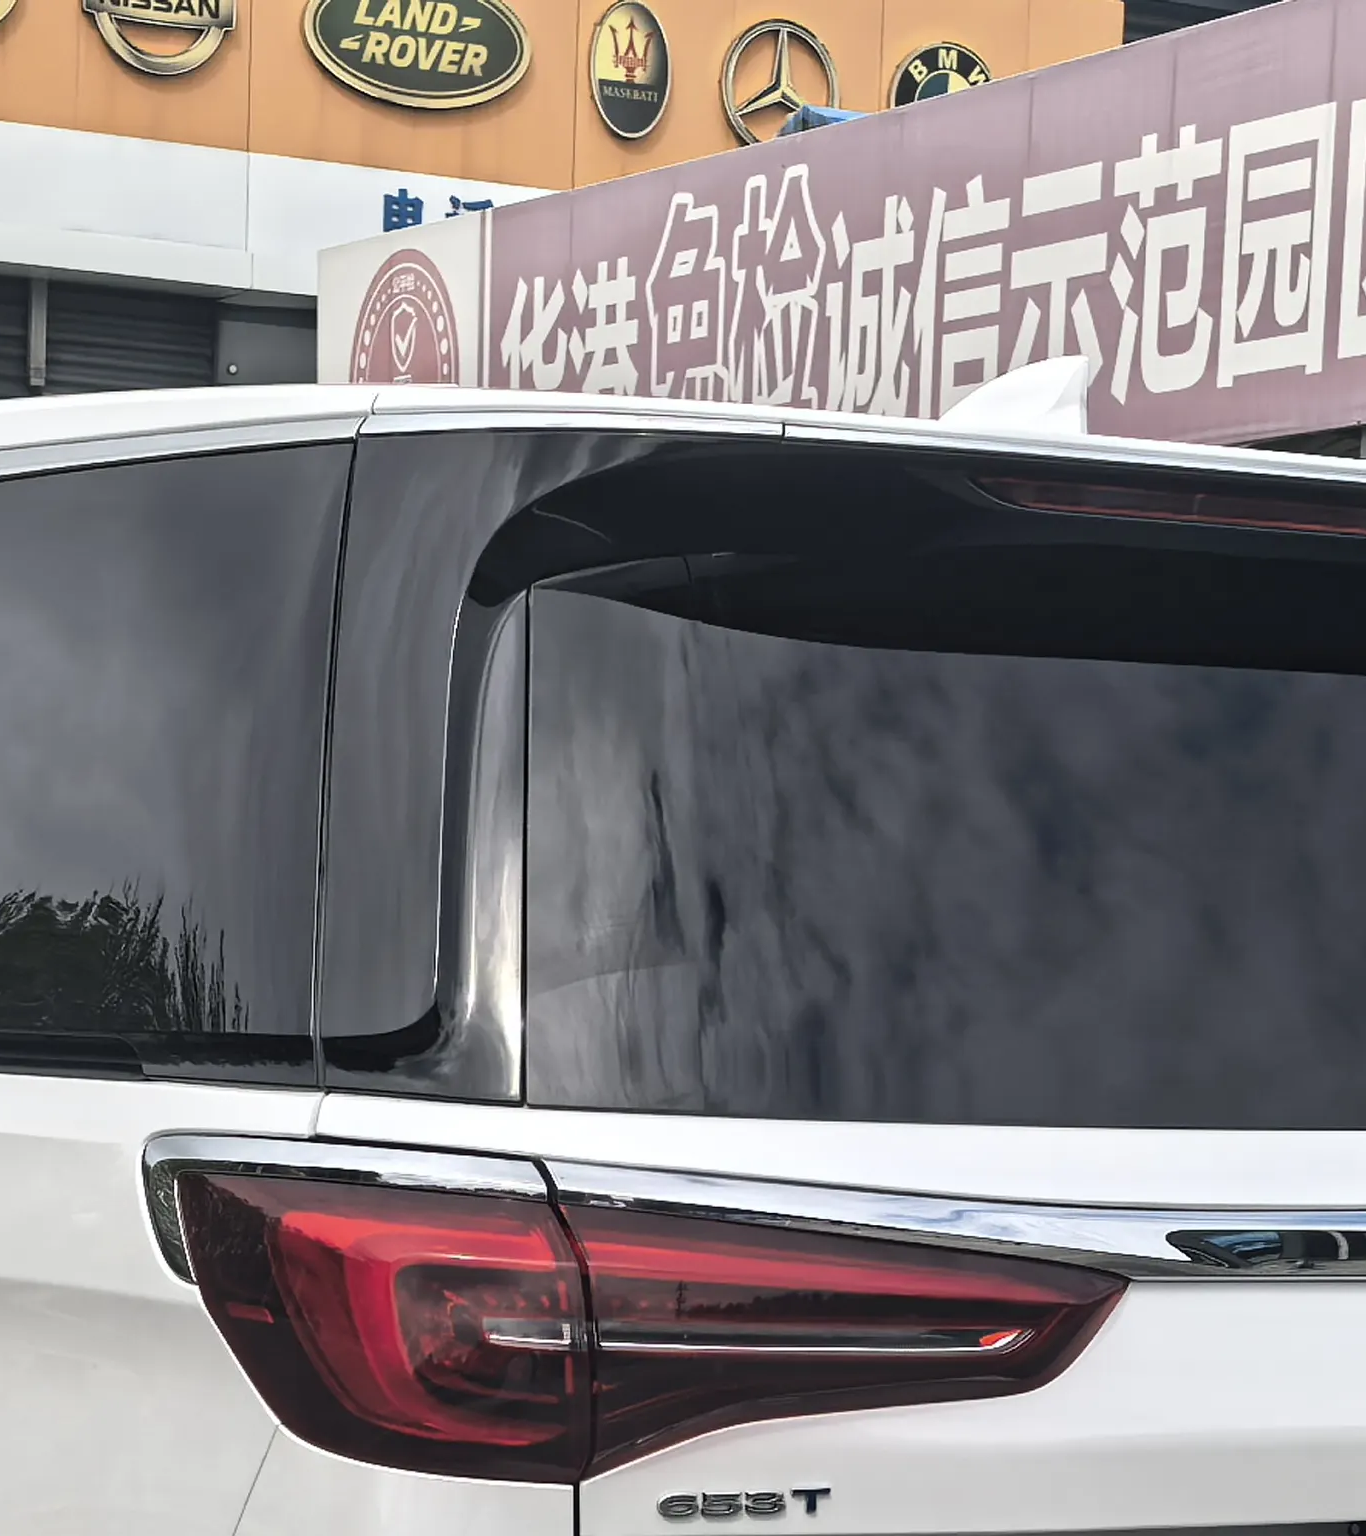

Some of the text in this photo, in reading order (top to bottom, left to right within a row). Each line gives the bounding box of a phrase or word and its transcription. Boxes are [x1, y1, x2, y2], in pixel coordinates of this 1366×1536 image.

[99, 0, 220, 19] SAN
[353, 0, 457, 33] LAND
[362, 31, 489, 76] ROVER
[908, 48, 986, 86] BMW
[602, 85, 659, 103] MASERATI
[656, 1487, 831, 1519] 653T
